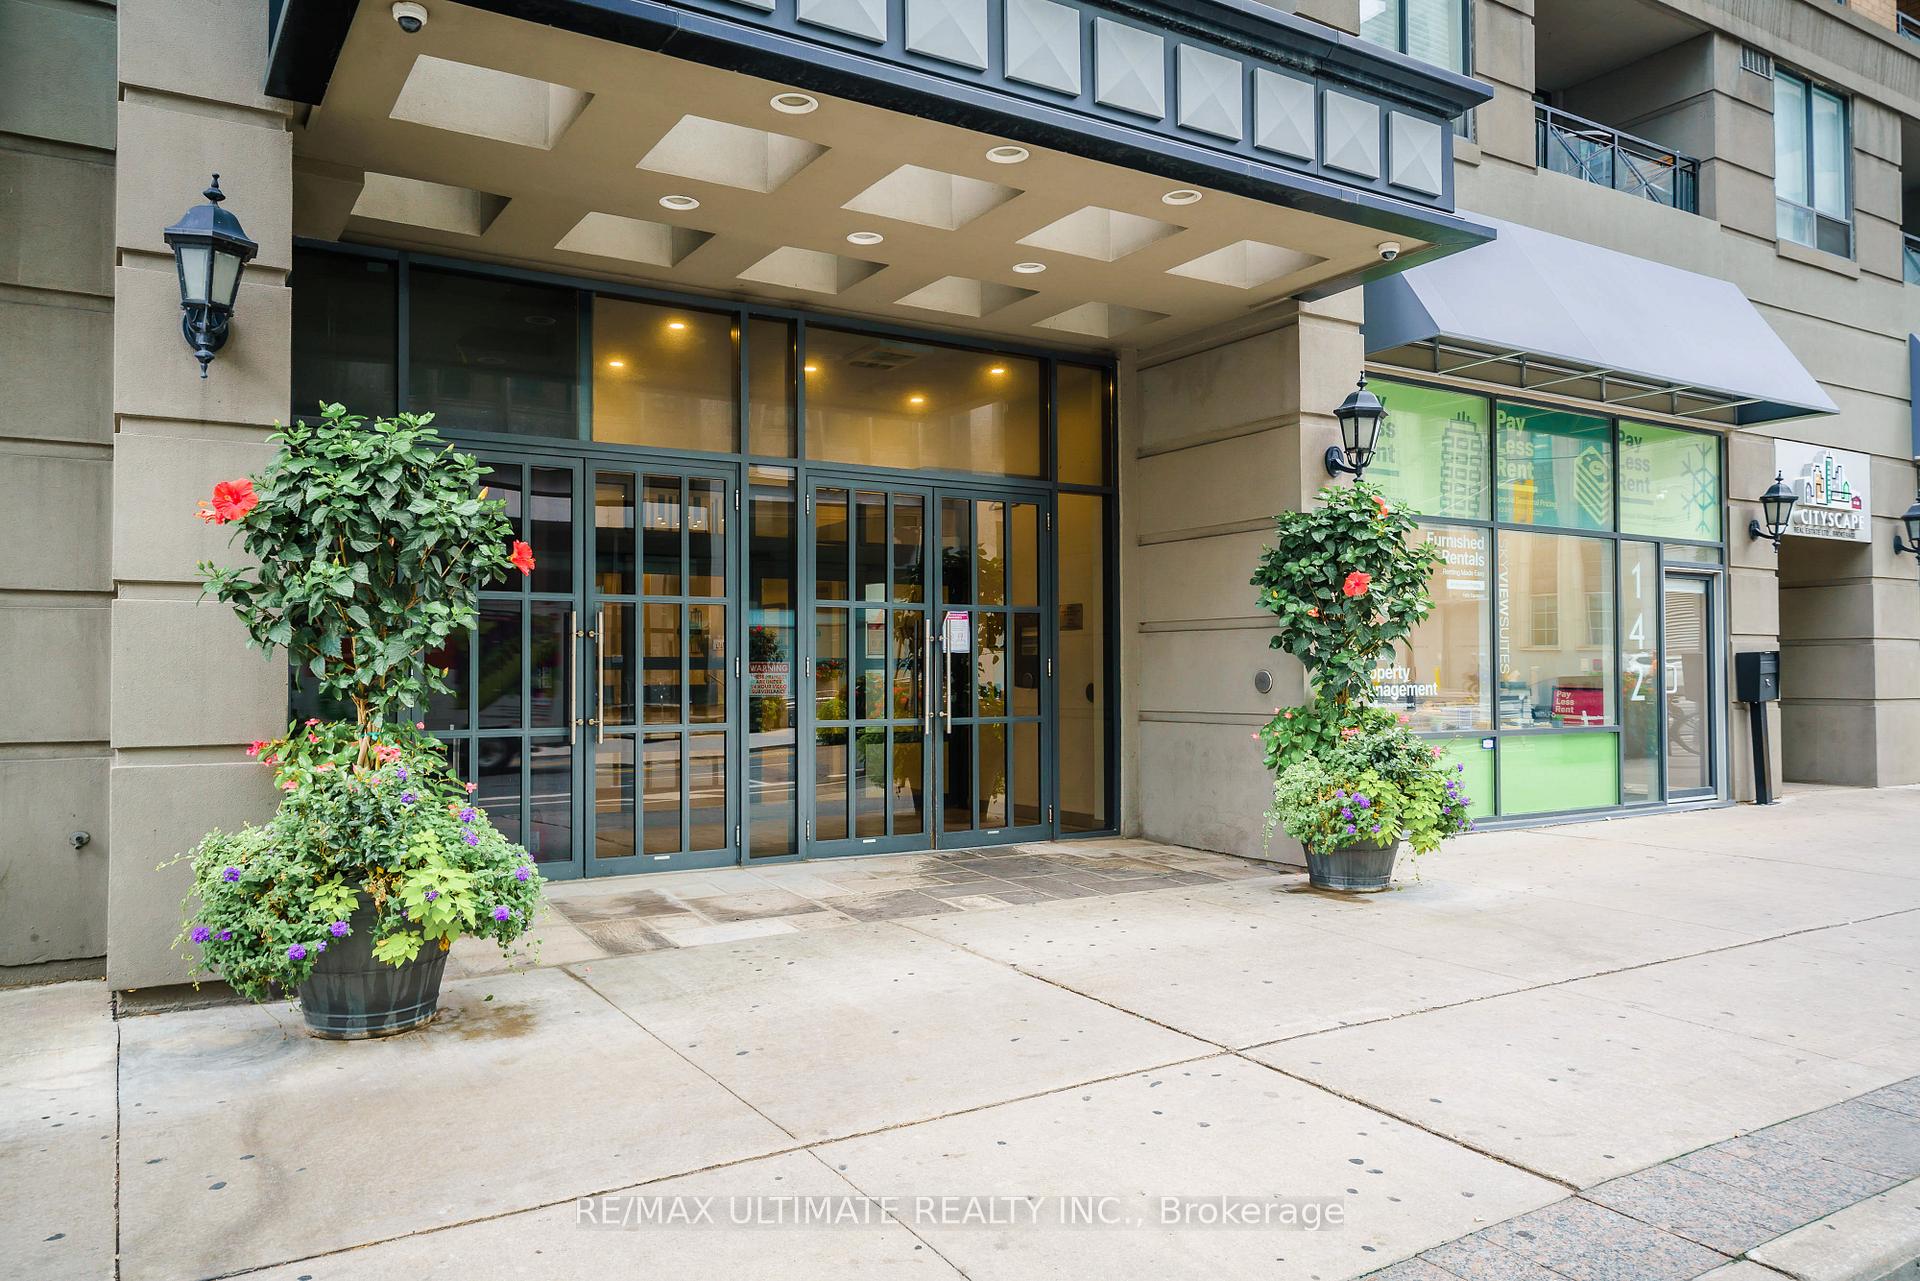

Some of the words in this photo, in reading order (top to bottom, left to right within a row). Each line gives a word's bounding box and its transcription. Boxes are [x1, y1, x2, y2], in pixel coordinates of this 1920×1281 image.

[1496, 410, 1526, 437] Pay
[1496, 432, 1535, 457] Less
[1496, 456, 1535, 480] Rent
[1618, 456, 1651, 473] ess
[1800, 508, 1865, 530] CITYSCAPE
[1426, 531, 1485, 550] Furnished
[1441, 549, 1486, 567] Rentals
[749, 664, 788, 672] WARNING
[1370, 665, 1410, 682] operty
[1369, 682, 1439, 700] nagement
[1556, 690, 1572, 698] Pay
[1555, 698, 1575, 706] Less
